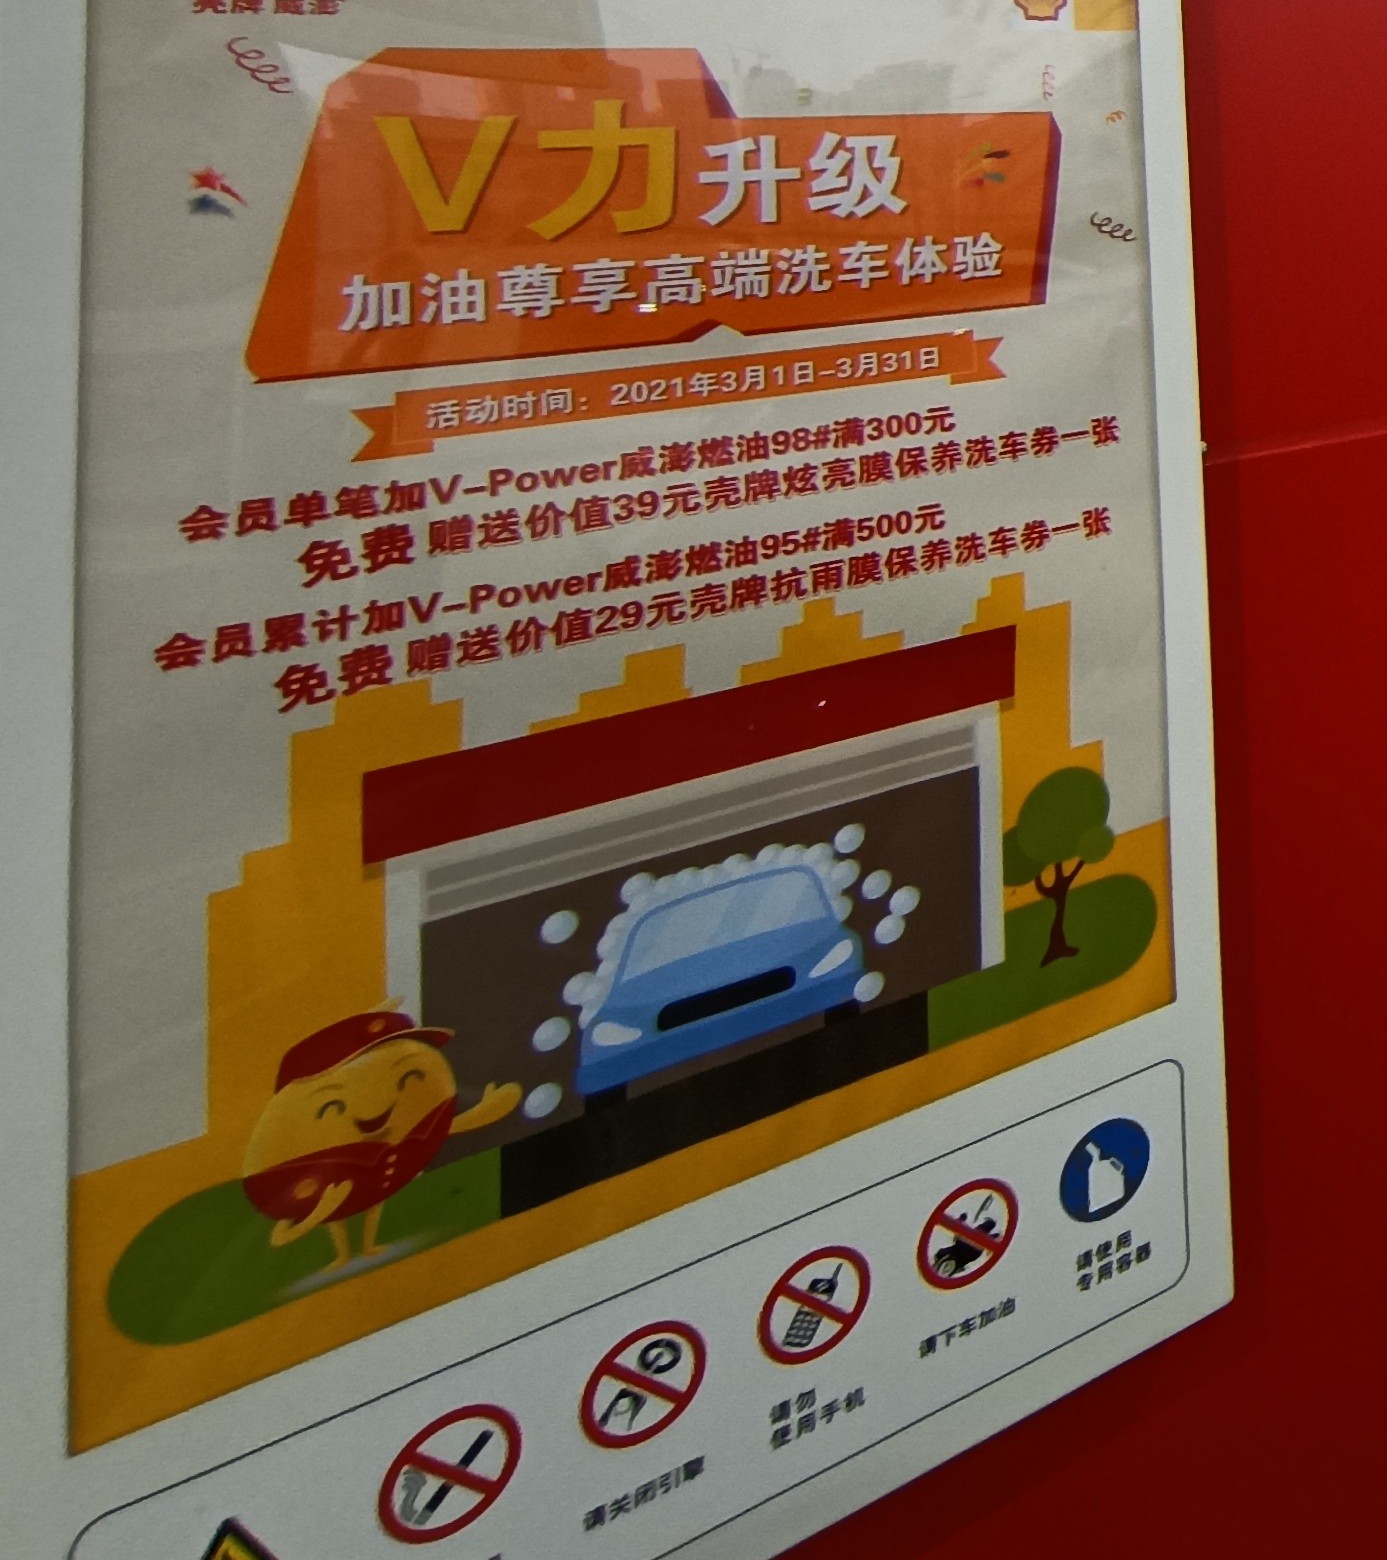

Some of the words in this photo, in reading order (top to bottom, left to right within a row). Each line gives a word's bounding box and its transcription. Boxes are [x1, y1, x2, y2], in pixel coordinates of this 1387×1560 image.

[338, 231, 1004, 333] 加油尊享高端洗车体验
